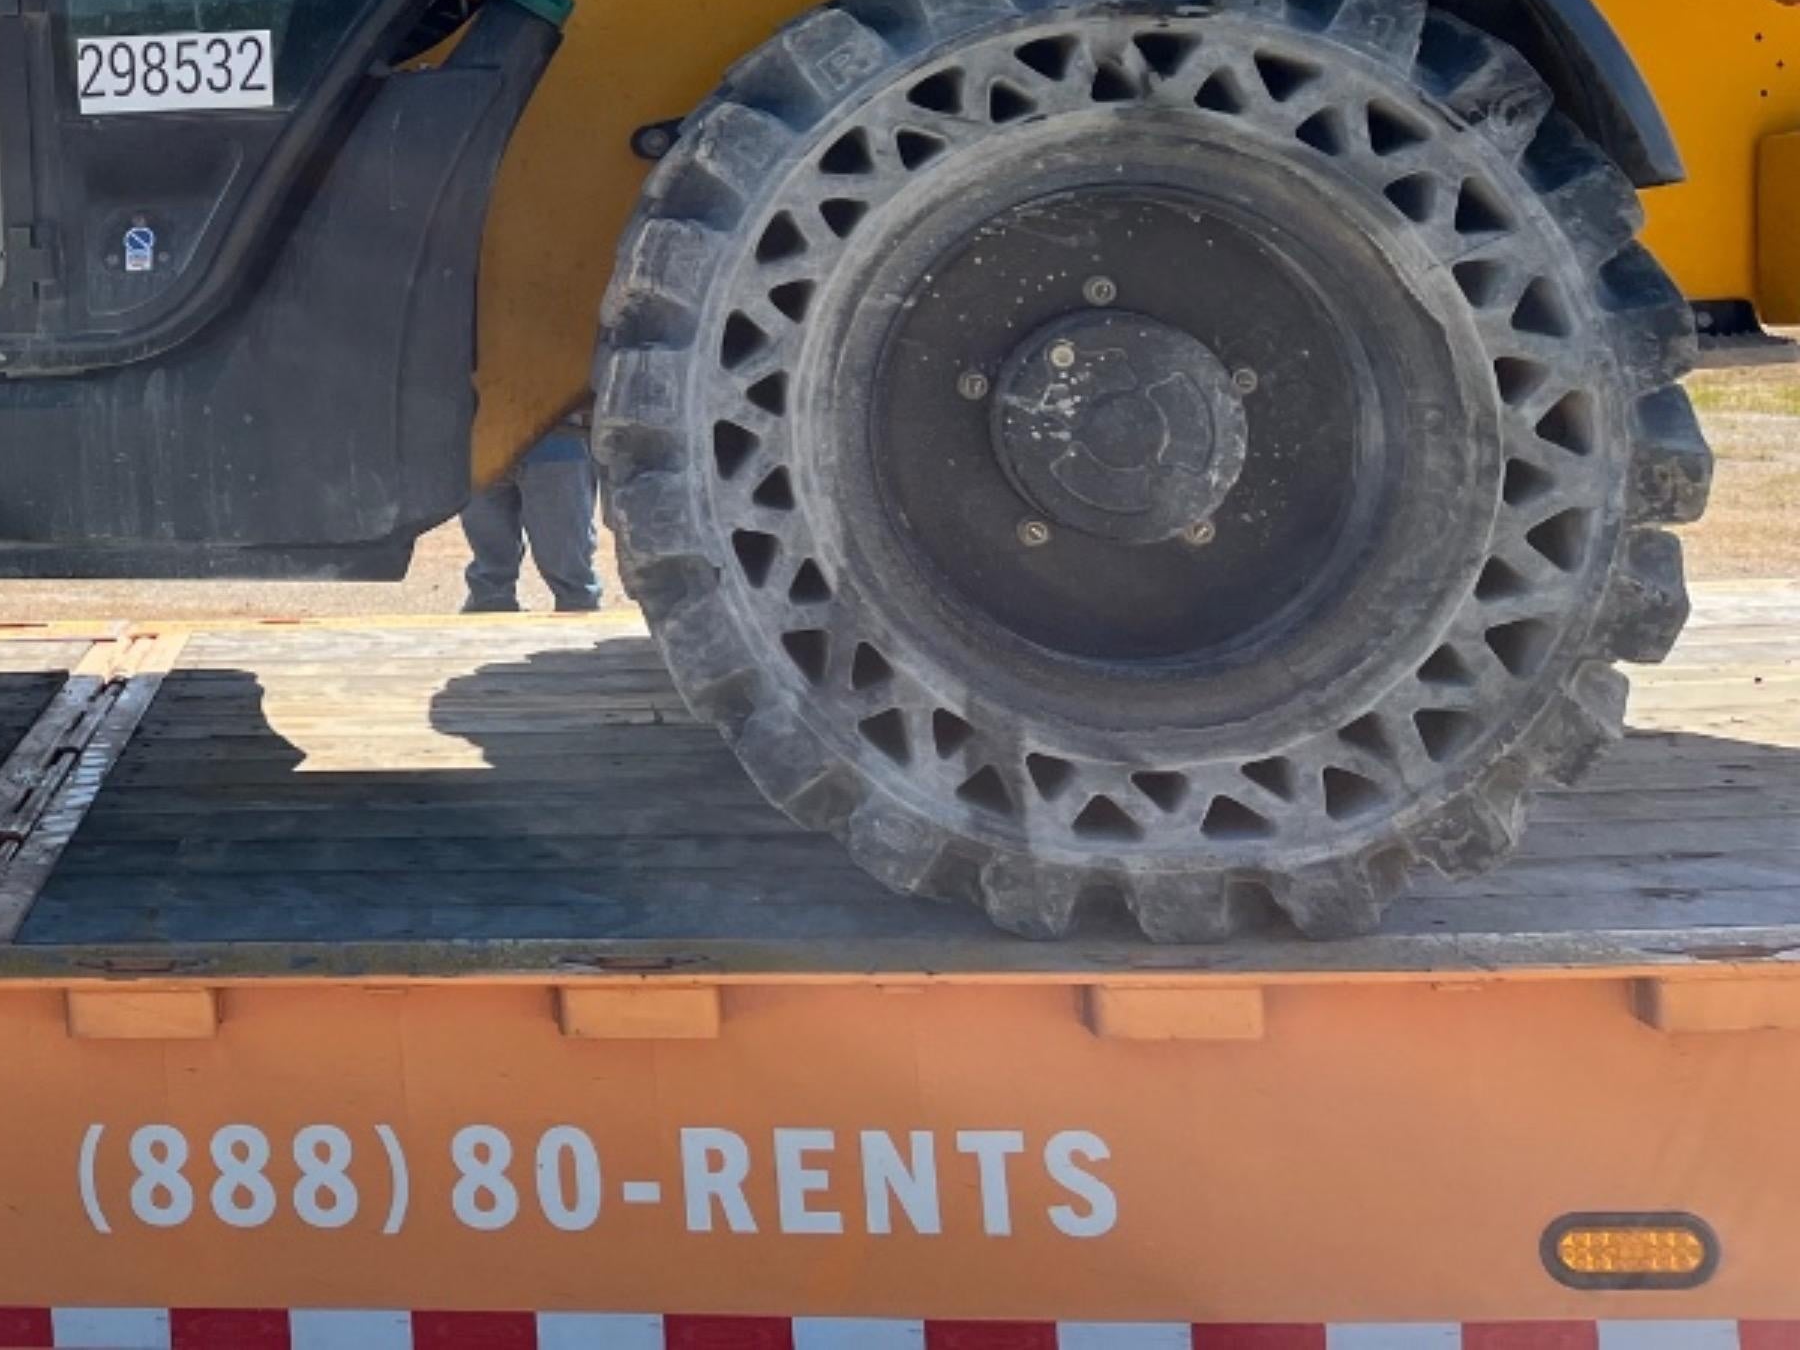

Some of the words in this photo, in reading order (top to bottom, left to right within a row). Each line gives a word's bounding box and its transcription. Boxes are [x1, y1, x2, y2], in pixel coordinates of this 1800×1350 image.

[78, 36, 267, 97] 298532
[78, 1123, 409, 1234] (888)
[452, 1123, 1117, 1237] 80-RENTS
